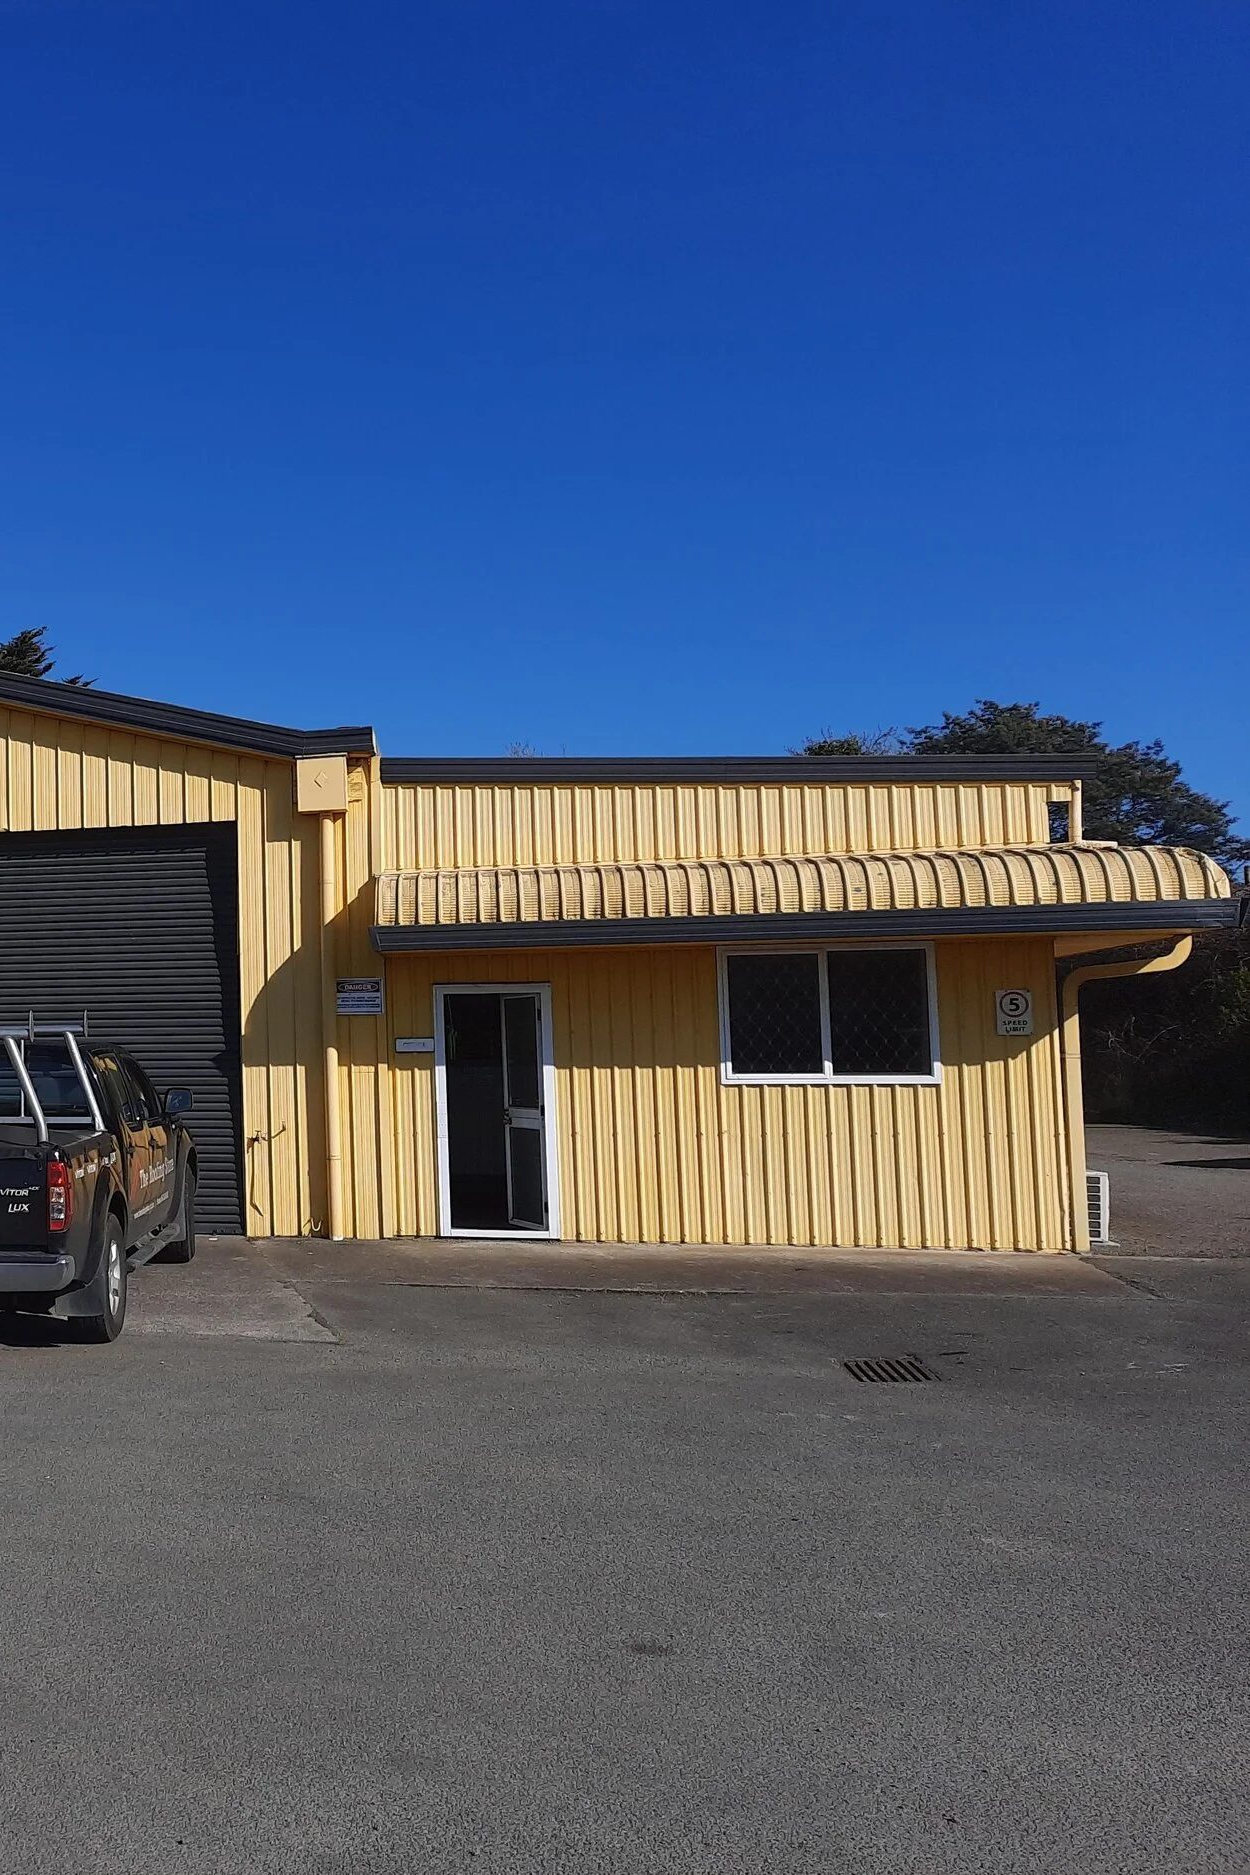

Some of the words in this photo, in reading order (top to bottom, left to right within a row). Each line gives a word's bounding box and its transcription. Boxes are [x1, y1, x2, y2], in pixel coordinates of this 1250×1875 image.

[1009, 998, 1020, 1012] 5
[0, 1187, 29, 1196] VITOR
[8, 1203, 30, 1213] LUX
